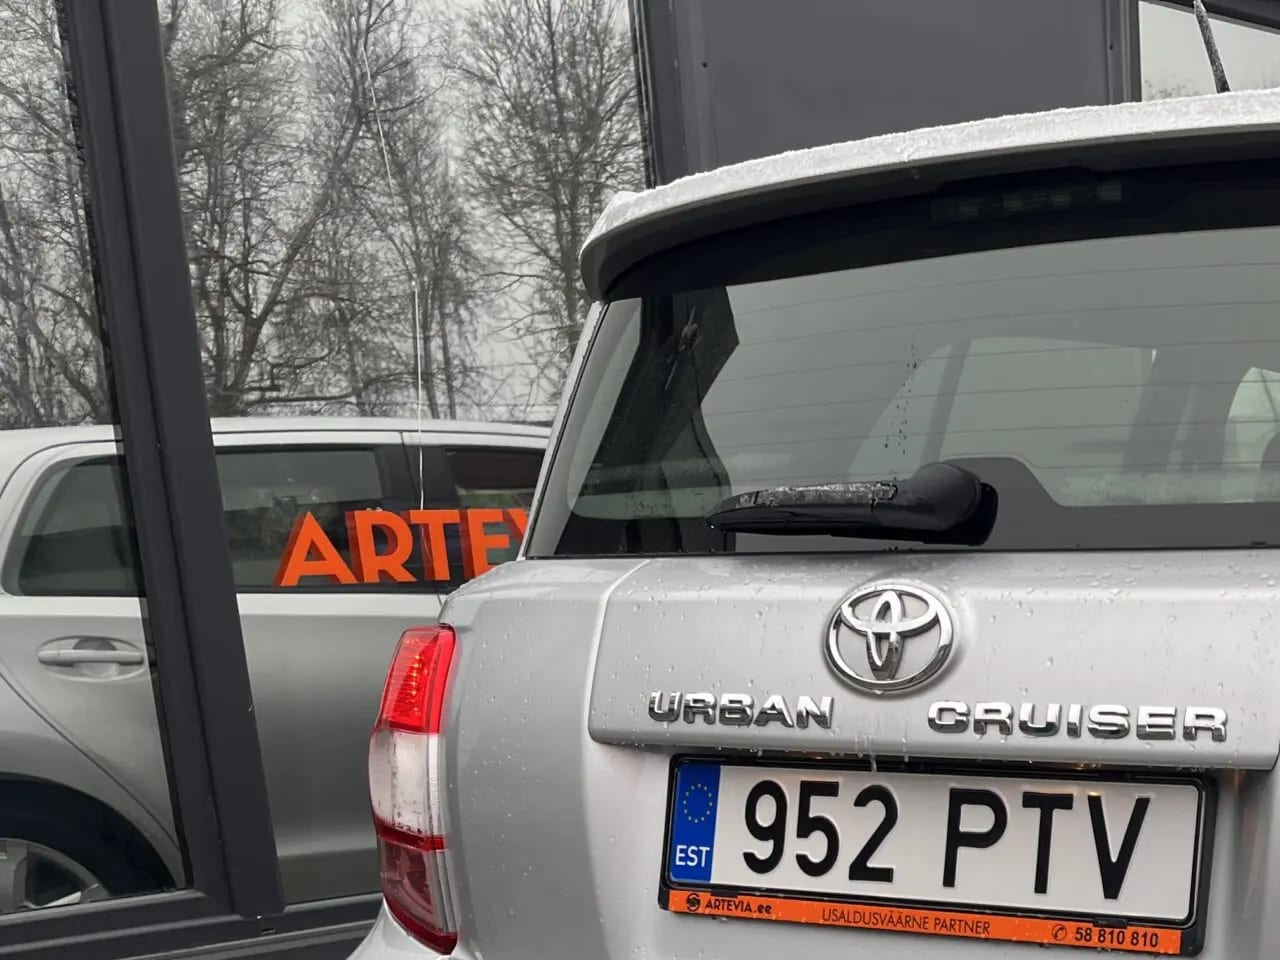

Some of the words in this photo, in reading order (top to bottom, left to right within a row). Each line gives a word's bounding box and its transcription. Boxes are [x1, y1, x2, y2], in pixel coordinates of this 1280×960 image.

[279, 508, 530, 587] ARTE
[648, 691, 834, 729] URBAN
[927, 700, 1228, 742] CRUISER
[743, 779, 898, 882] 952
[943, 787, 1151, 900] PTV
[675, 844, 711, 868] EST
[704, 898, 772, 915] ARTEVIA.ee
[822, 907, 930, 931] USALDUSVÄÄRNE
[934, 917, 991, 935] PARTNER
[1075, 927, 1092, 942] 58
[1098, 929, 1125, 945] 810
[1130, 931, 1159, 947] 810
